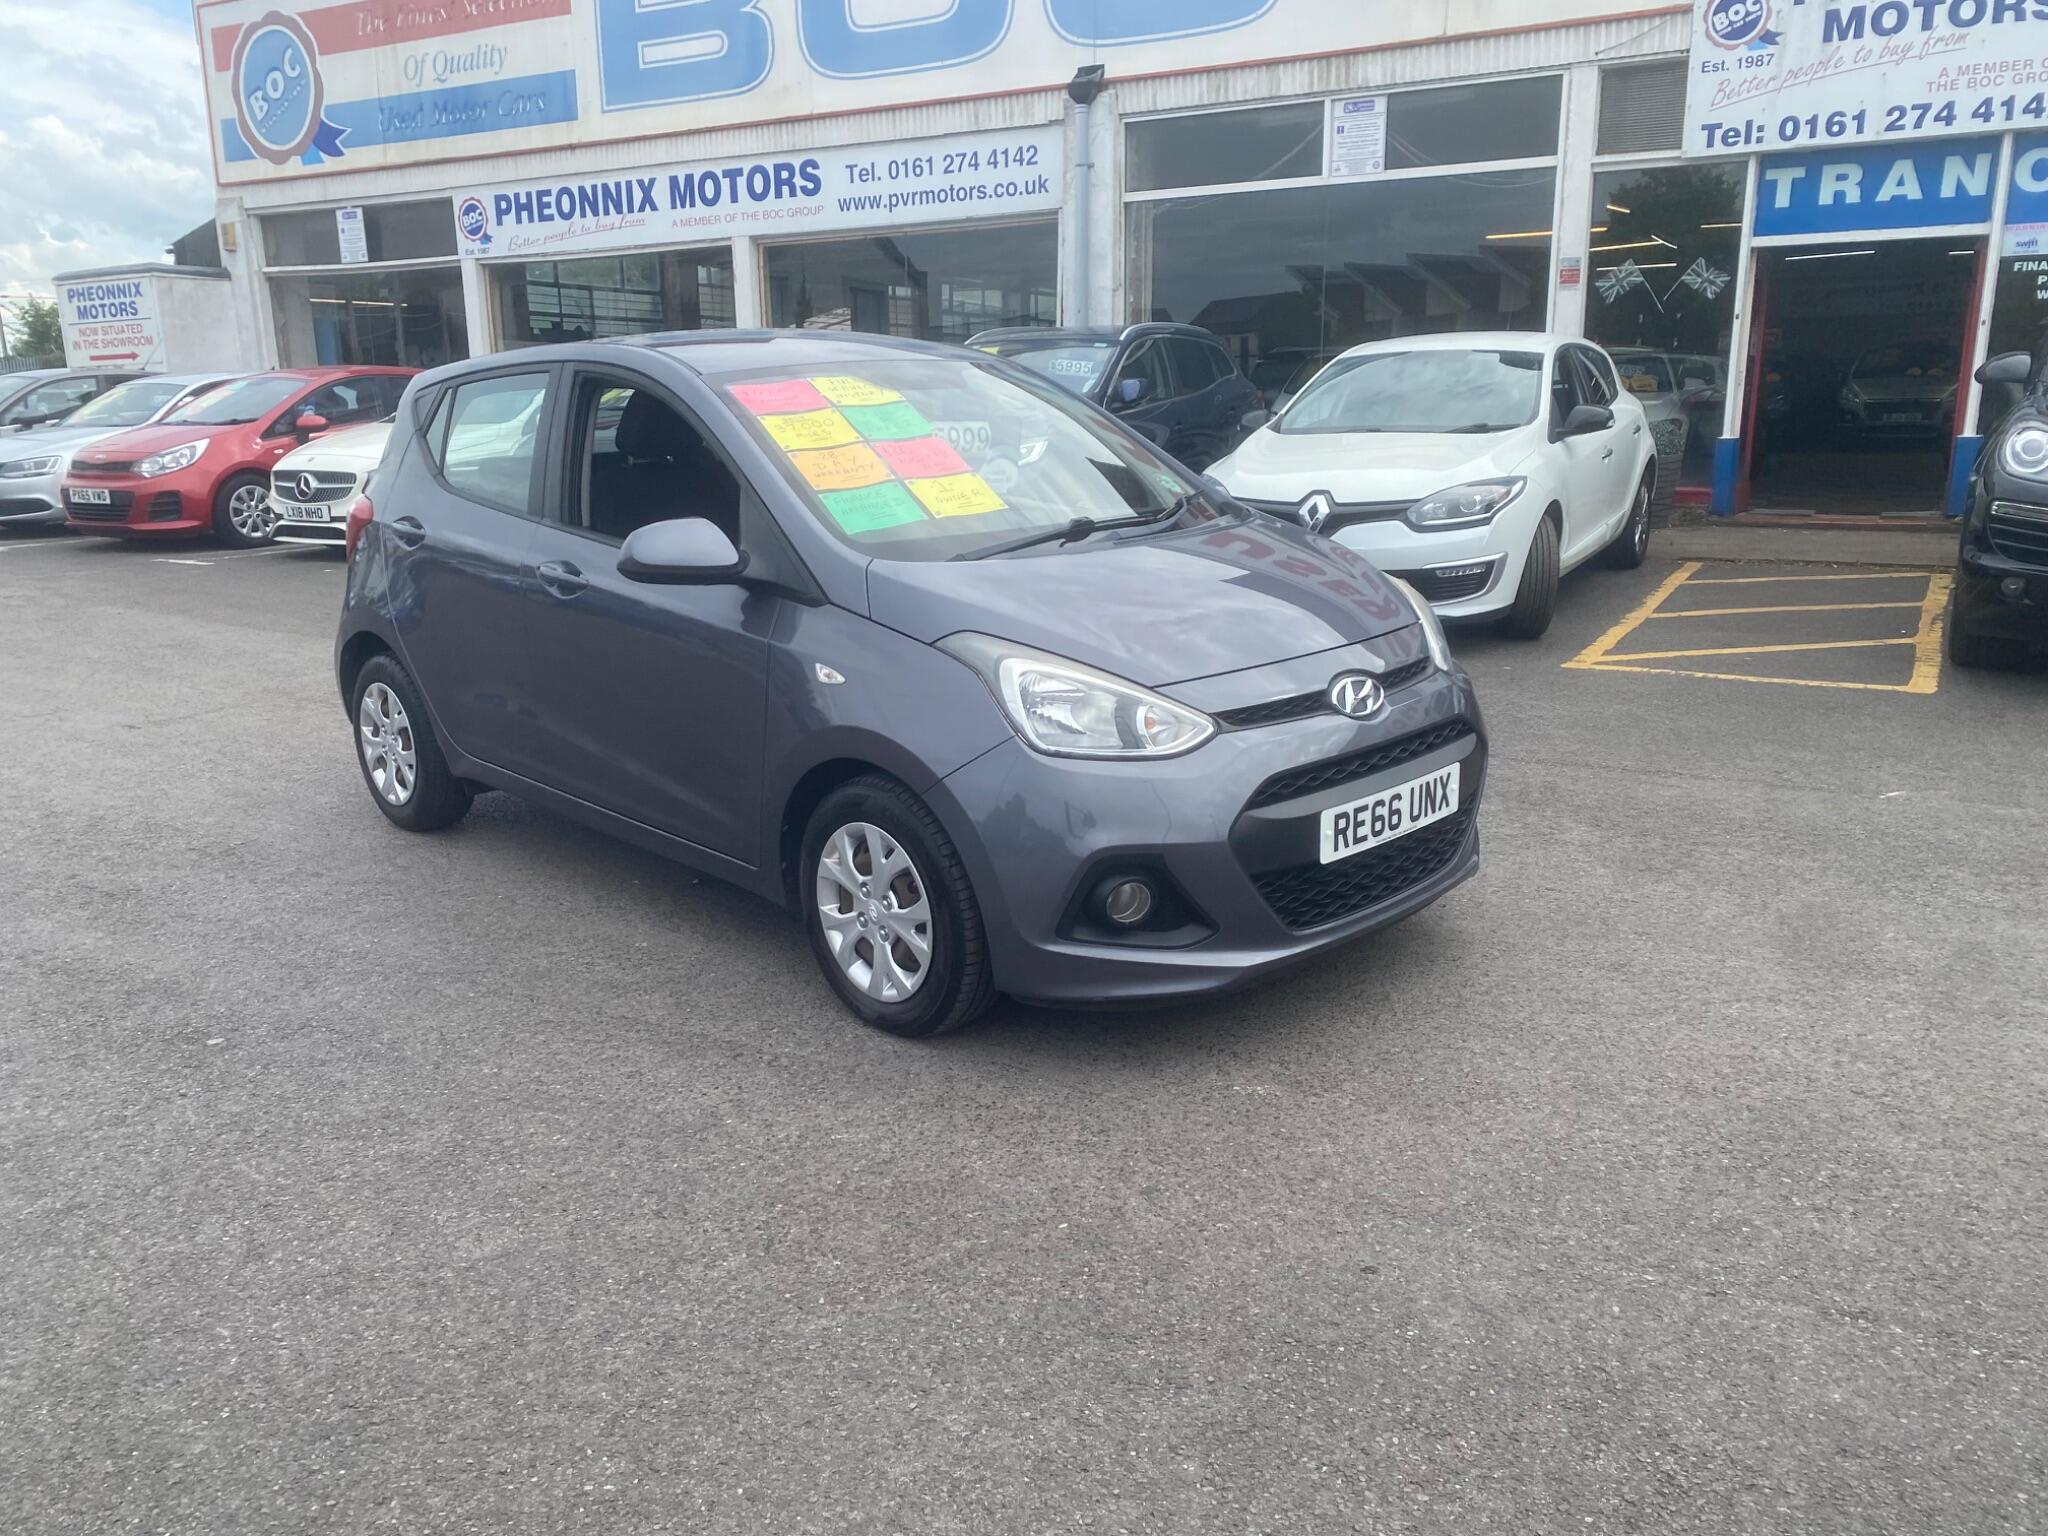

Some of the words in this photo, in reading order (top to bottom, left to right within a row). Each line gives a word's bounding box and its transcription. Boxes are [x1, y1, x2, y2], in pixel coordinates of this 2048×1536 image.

[1822, 0, 2048, 43] MOTOR
[402, 50, 430, 87] Of
[433, 44, 509, 83] Quality
[1701, 60, 1730, 73] Est.
[1737, 53, 1775, 70] 1987
[1710, 75, 1778, 108] Better
[1778, 46, 1846, 94] people
[1853, 46, 1873, 65] to
[1919, 24, 1971, 60] from
[1938, 67, 1950, 79] A
[1957, 59, 2034, 77] MEMBER
[249, 47, 301, 120] BOC
[1927, 79, 1960, 93] THE
[1967, 74, 2005, 89] BOC
[498, 89, 547, 118] Cars
[1701, 119, 1766, 149] Tel:
[1778, 109, 1867, 142] 0161
[1883, 100, 1957, 133] 274
[1971, 92, 2048, 123] 414
[845, 162, 882, 184] Tel.
[888, 155, 934, 180] 0161
[943, 150, 980, 175] 274
[987, 144, 1039, 170] 4142
[494, 177, 659, 227] PHEONNIX
[668, 158, 822, 210] MOTORS
[838, 173, 1049, 213] www.pvrmotors.co.uk
[462, 207, 484, 227] BOC
[671, 218, 679, 229] A
[680, 214, 721, 228] MEMBER
[724, 212, 738, 224] OF
[741, 209, 761, 222] THE
[763, 207, 784, 220] BOC
[787, 204, 824, 218] GROUP
[66, 282, 143, 304] PHEONNIX
[76, 300, 139, 321] MOTORS
[72, 340, 82, 351] IN
[82, 339, 100, 350] THE
[101, 335, 154, 350] SHOWROOM
[78, 325, 99, 337] NOW
[101, 323, 144, 337] SITUATED
[304, 506, 324, 519] NHO
[1333, 793, 1403, 853] RE66
[1409, 772, 1452, 823] UNX
